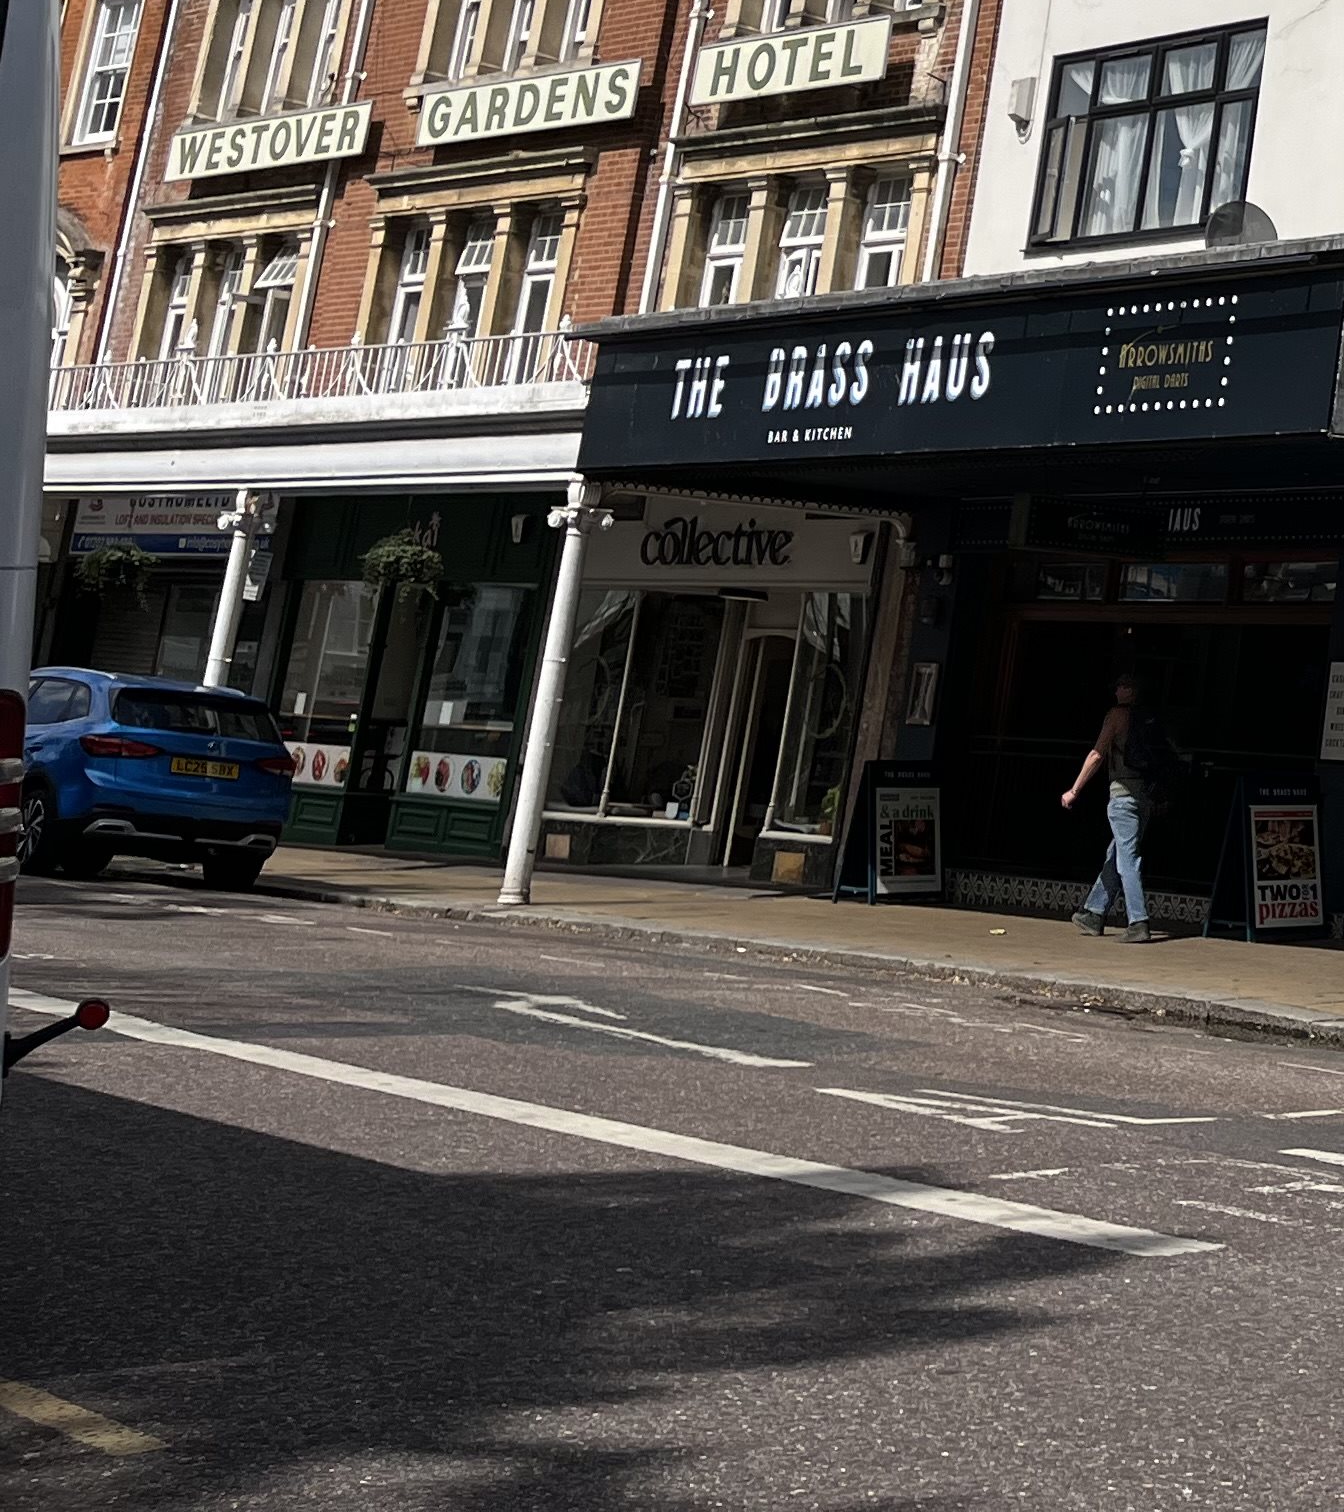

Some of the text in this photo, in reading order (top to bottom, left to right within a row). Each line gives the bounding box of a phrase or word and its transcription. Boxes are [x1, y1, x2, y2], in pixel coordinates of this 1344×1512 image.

[708, 29, 863, 97] HOTEL
[427, 67, 630, 139] GARDENS
[179, 109, 360, 175] WESTOVER
[670, 330, 996, 420] THE BRASS HAUS
[1118, 339, 1214, 370] ARROWSMITHS
[1133, 372, 1190, 391] DIGITAL DARTS
[766, 425, 854, 444] BAR & KITCHEN
[640, 515, 795, 566] collective
[880, 803, 935, 819] & a drink
[880, 819, 894, 877] MEAL
[1257, 884, 1301, 902] TWO
[1310, 883, 1319, 901] 1
[1258, 901, 1320, 925] pizzas
